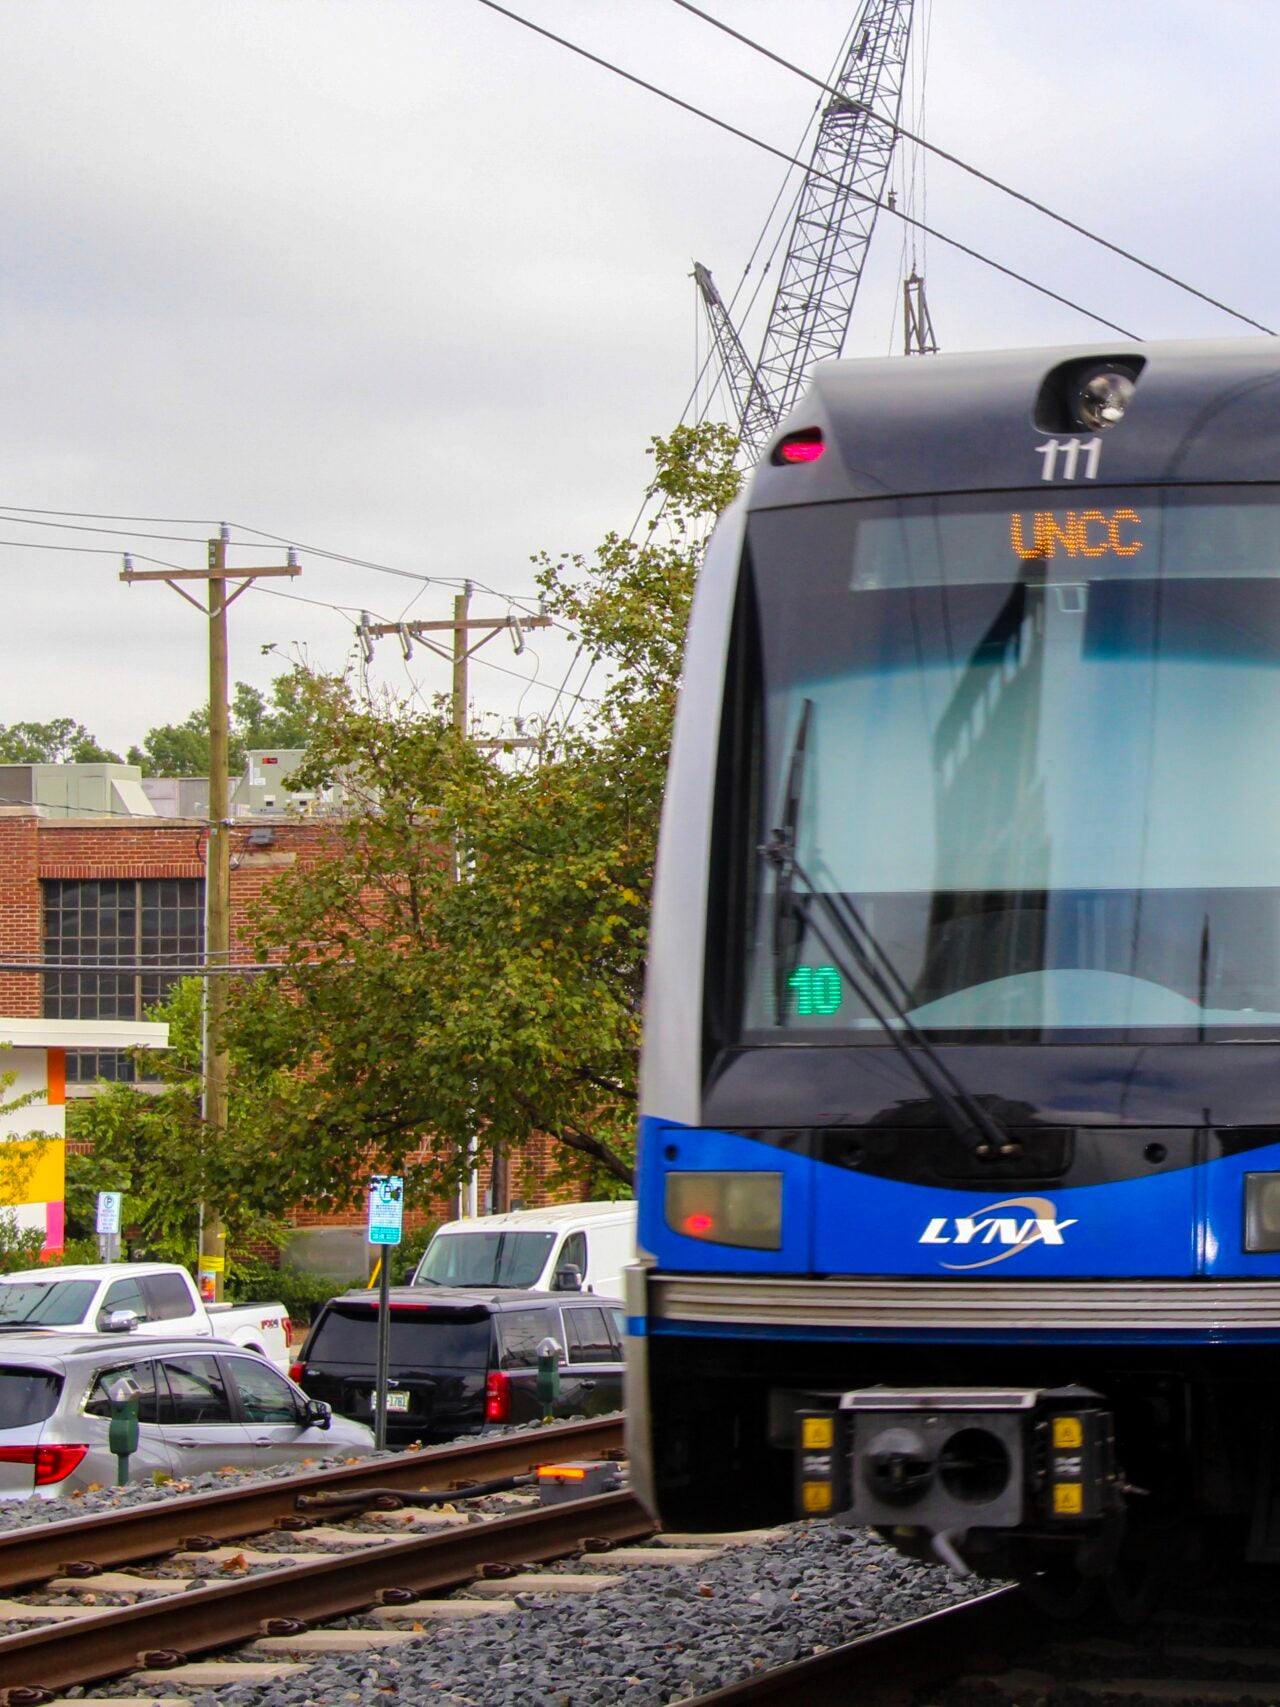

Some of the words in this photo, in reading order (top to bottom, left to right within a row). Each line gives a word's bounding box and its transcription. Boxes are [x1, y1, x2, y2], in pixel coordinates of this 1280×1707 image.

[1034, 437, 1103, 481] 111
[1011, 508, 1143, 560] UNCC
[918, 1217, 1079, 1245] LYNX
